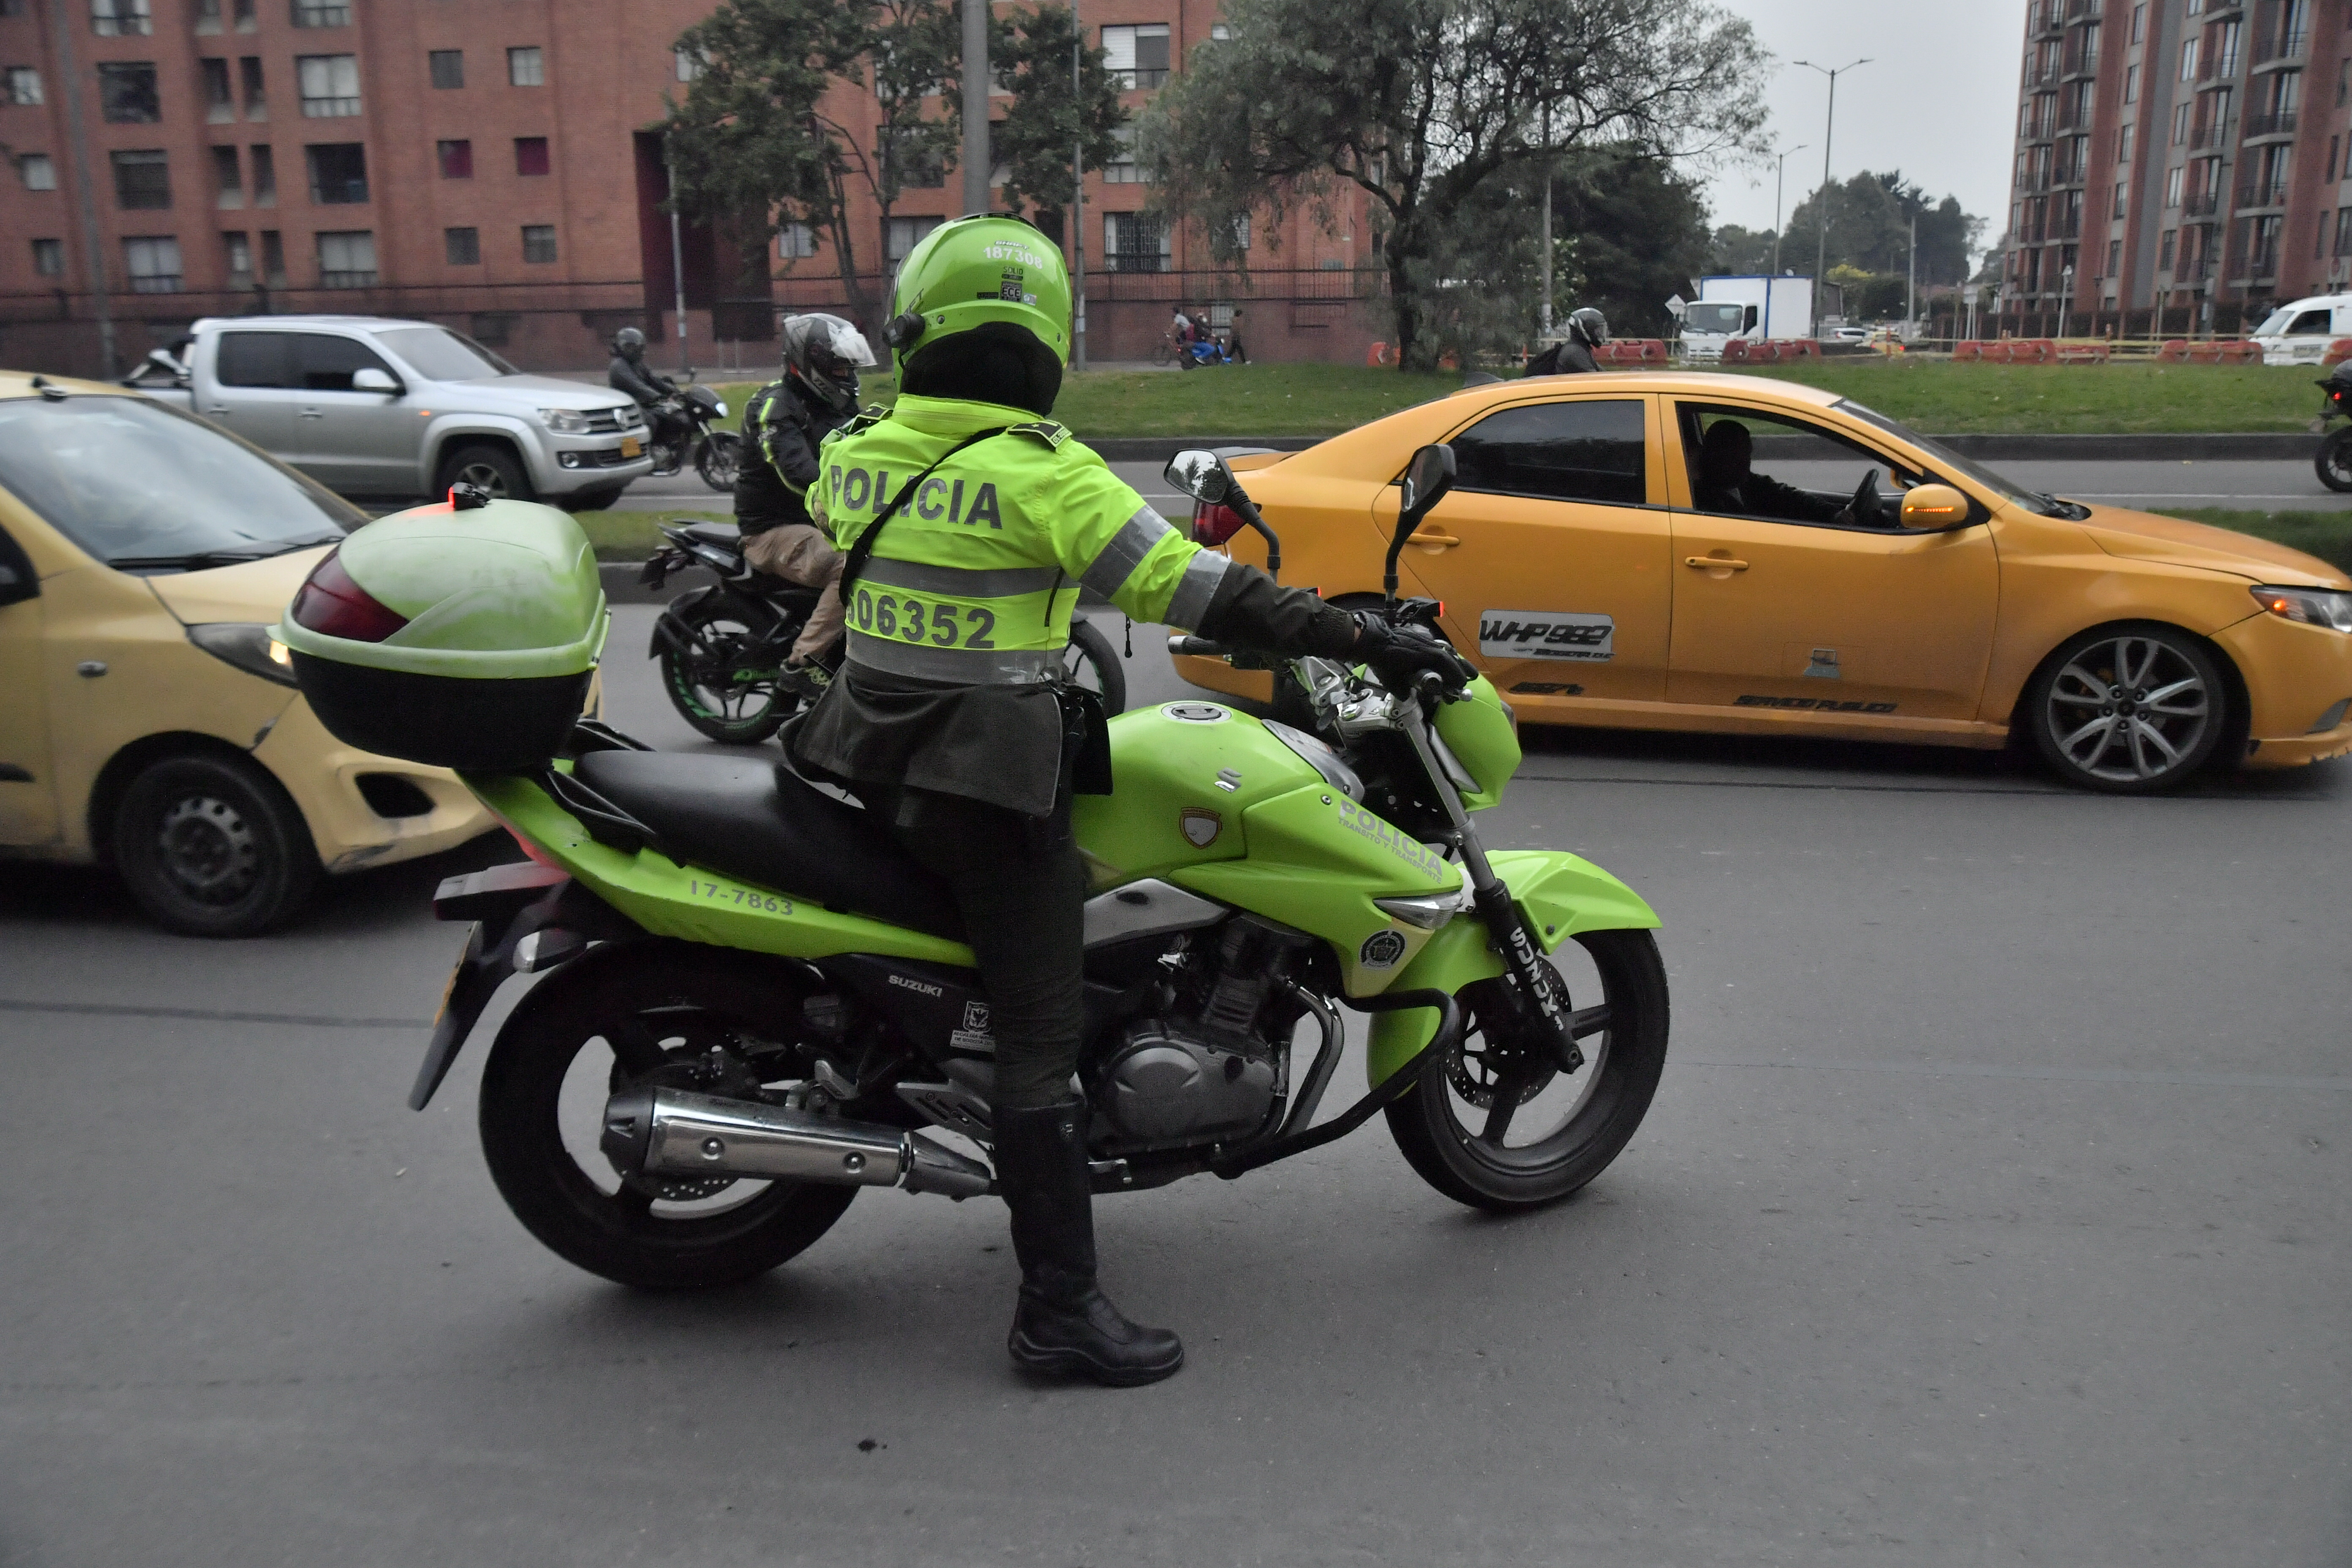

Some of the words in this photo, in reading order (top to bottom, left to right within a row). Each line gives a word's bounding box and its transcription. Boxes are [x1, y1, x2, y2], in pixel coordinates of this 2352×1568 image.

[994, 240, 1029, 250] SHAFT
[983, 246, 1043, 270] 187308
[1003, 266, 1024, 275] SOLID
[1002, 287, 1021, 298] ECE
[830, 465, 1002, 530] POLICIA
[1479, 620, 1613, 645] WHP982
[1339, 799, 1443, 877] POLICIA
[1338, 817, 1381, 844] TRANSITO
[1391, 845, 1442, 884] TRANSPORTE
[691, 880, 793, 915] 17-7863
[888, 975, 943, 998] SUZUKI
